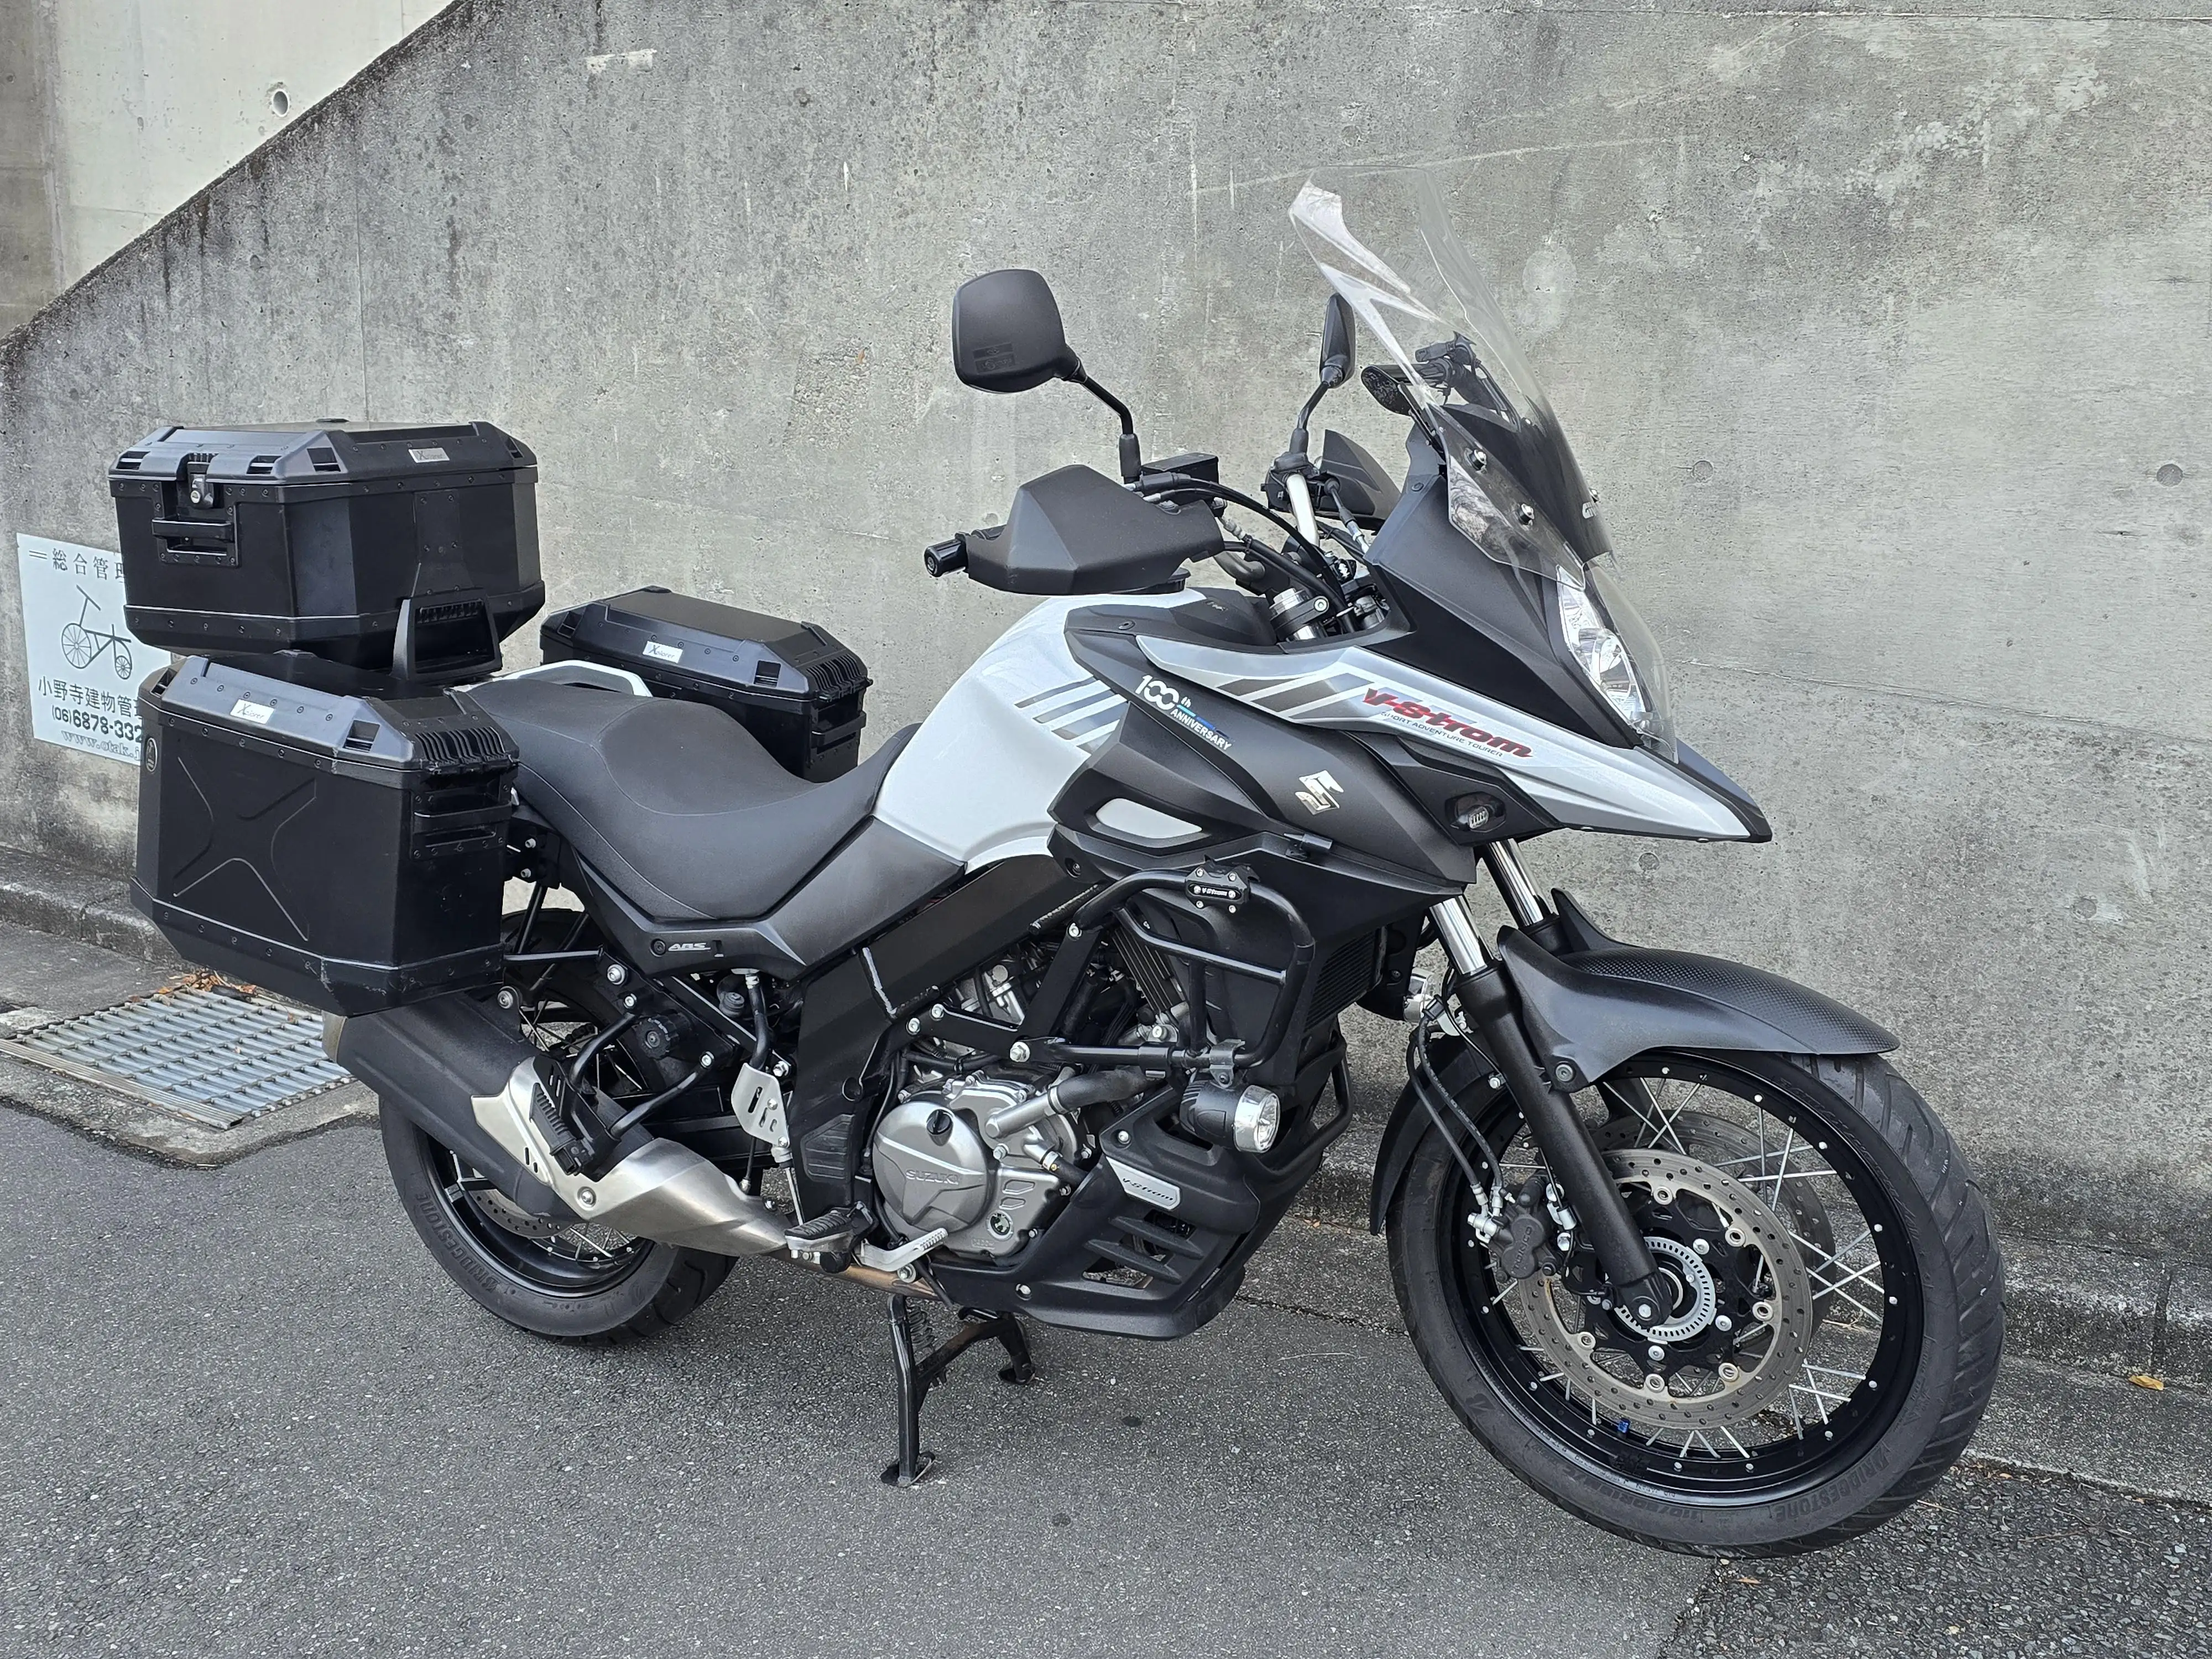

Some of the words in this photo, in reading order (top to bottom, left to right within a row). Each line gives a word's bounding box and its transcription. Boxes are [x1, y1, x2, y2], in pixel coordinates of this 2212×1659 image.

[1170, 708, 1232, 750] ANNIVERSARY
[1380, 711, 1410, 727] SPORT
[1412, 722, 1465, 744] ADVENTURE
[1468, 740, 1503, 758] TOURER
[668, 942, 711, 952] ABS
[906, 1170, 959, 1185] SUZUKI
[416, 1191, 500, 1293] BRIDGESTONE
[1775, 1442, 1890, 1522] BRIDGESTONE
